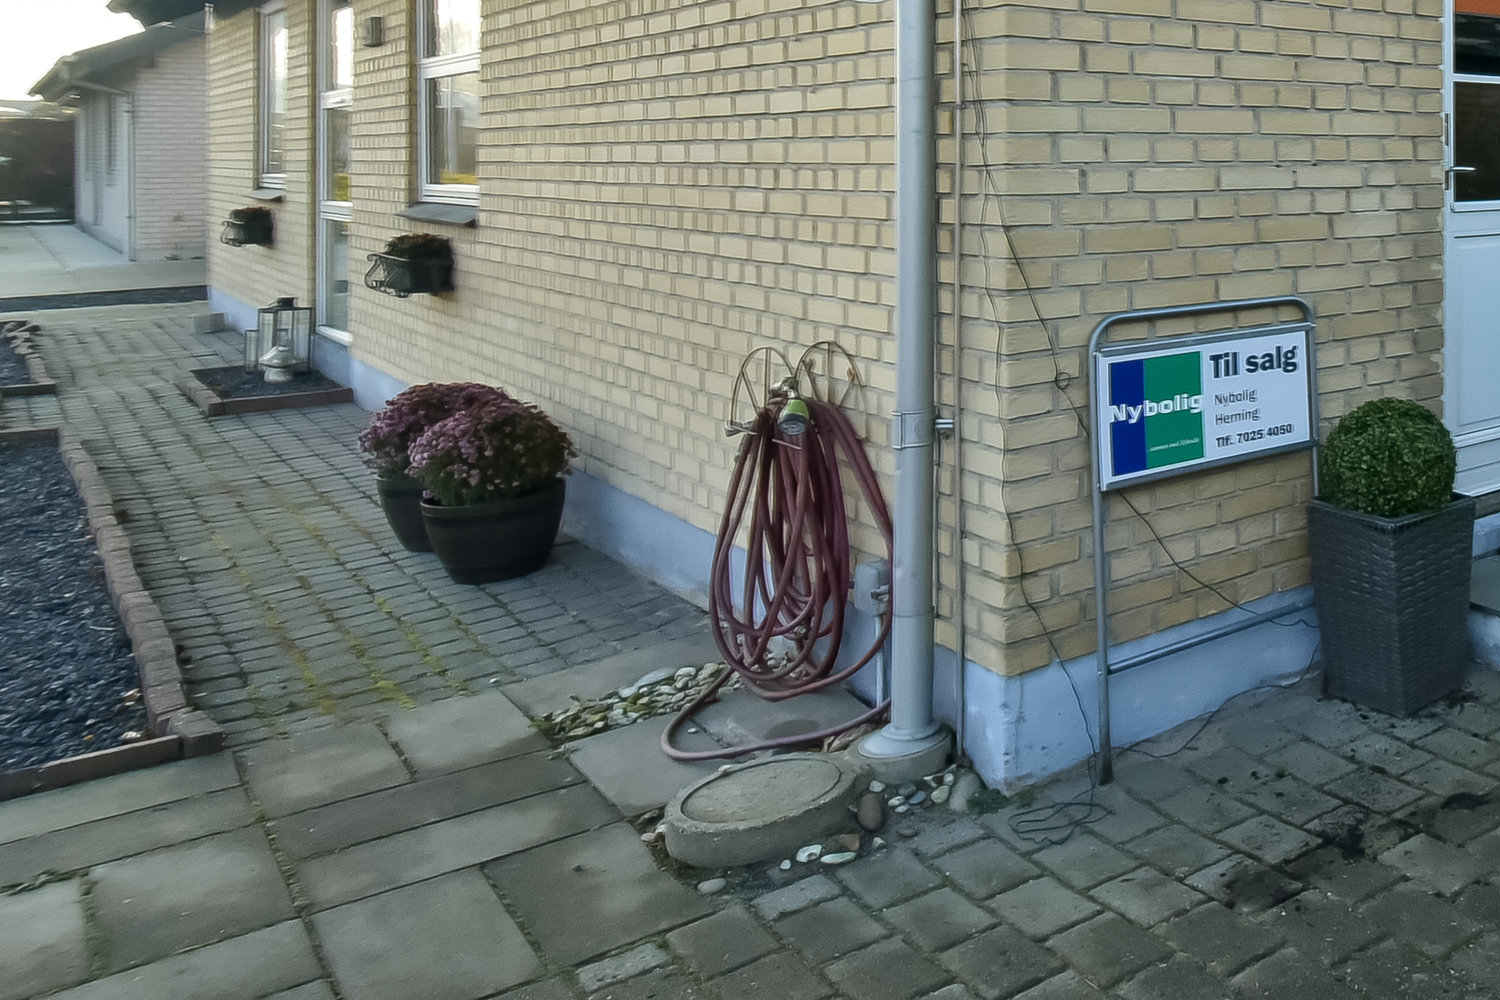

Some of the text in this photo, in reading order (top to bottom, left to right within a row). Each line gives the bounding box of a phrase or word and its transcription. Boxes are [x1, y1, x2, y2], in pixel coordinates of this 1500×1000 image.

[1209, 346, 1298, 378] Til salg
[1109, 393, 1203, 424] Nybolig
[1214, 389, 1256, 407] Nybolig
[1215, 408, 1260, 425] Herning
[1216, 424, 1293, 447] Tlf. 7025 4050
